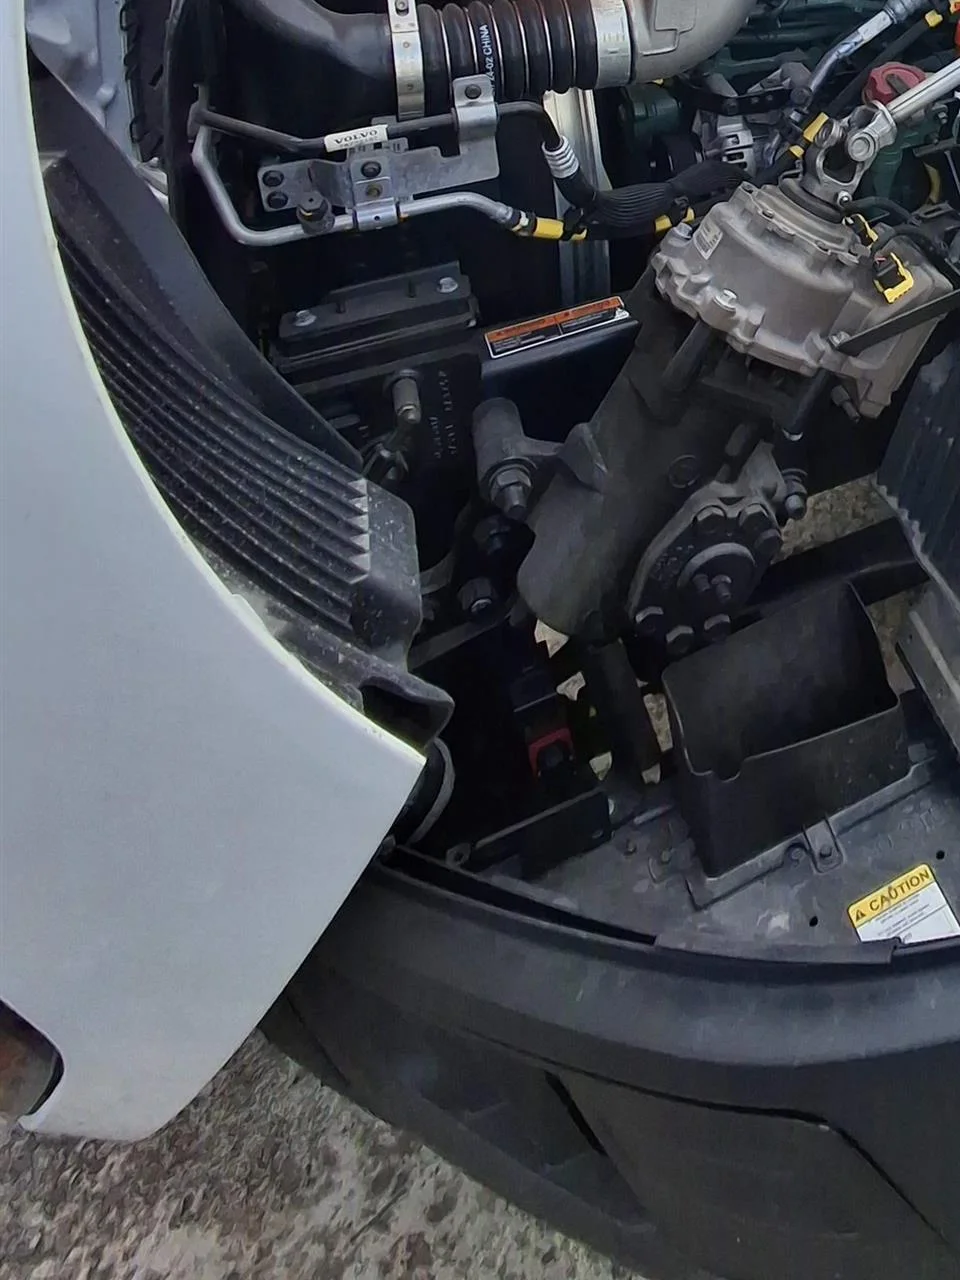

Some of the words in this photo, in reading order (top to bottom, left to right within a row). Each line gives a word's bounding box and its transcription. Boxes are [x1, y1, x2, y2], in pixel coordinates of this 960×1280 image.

[479, 24, 493, 55] CHINA
[334, 129, 378, 144] VOLVO
[869, 869, 930, 911] CAUTION
